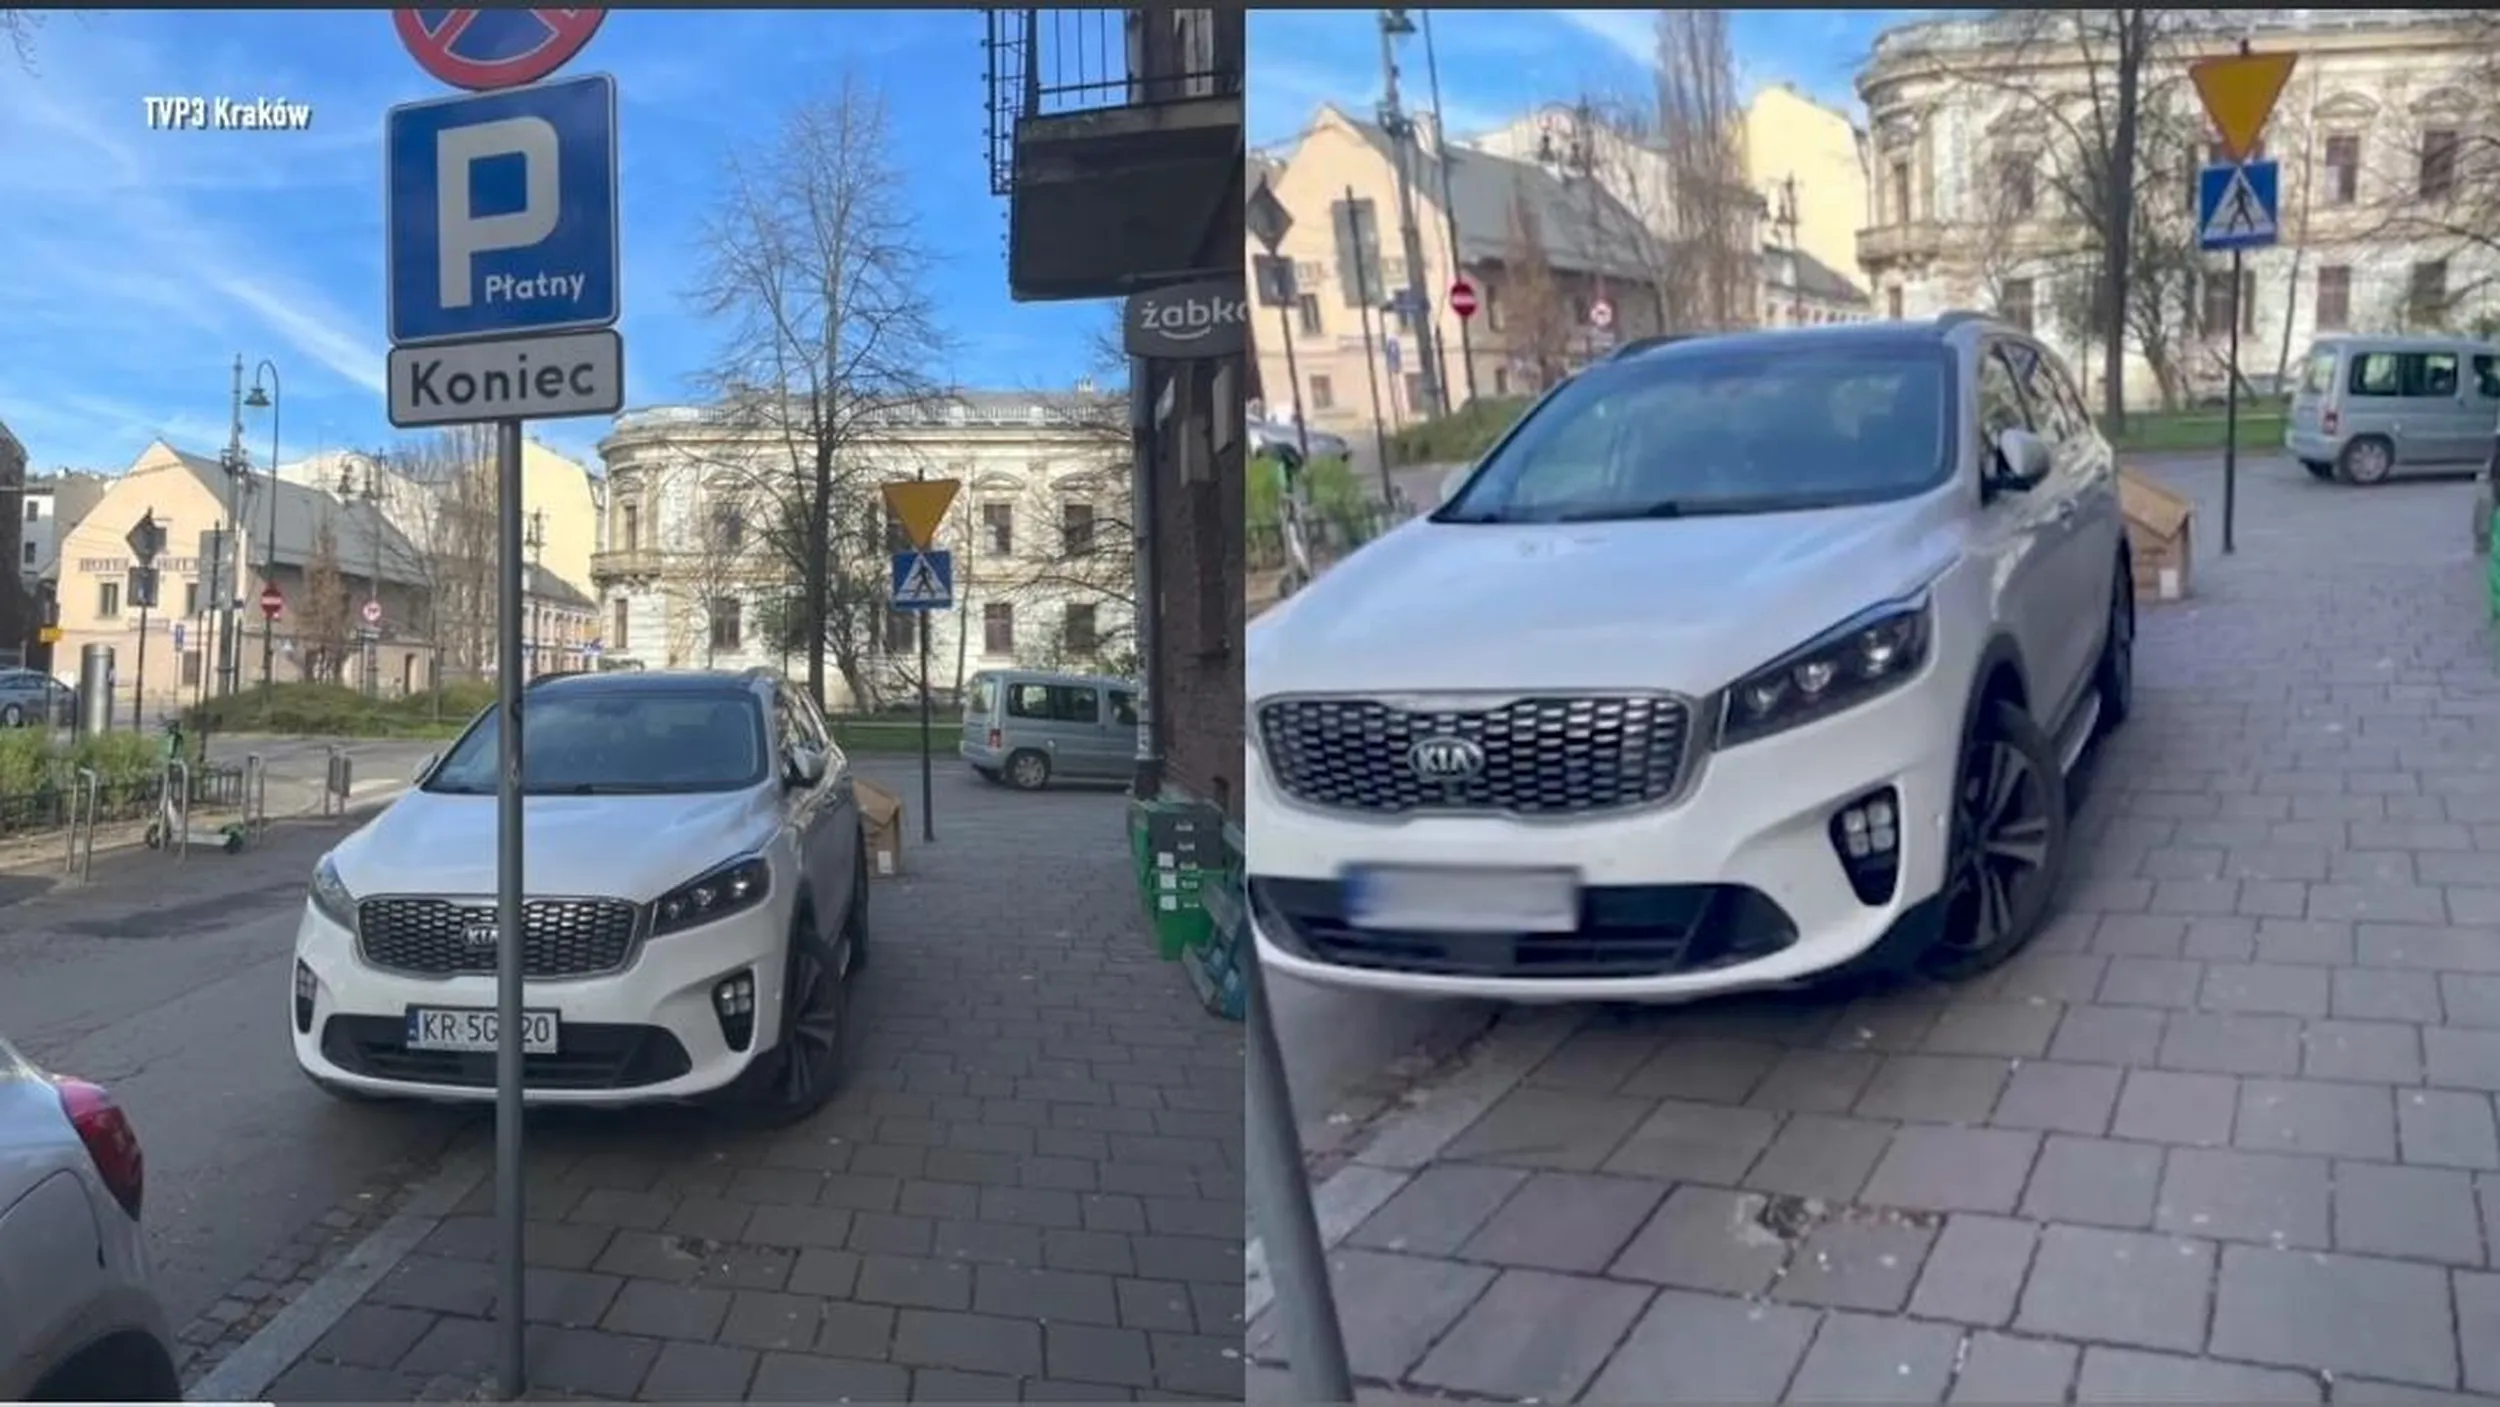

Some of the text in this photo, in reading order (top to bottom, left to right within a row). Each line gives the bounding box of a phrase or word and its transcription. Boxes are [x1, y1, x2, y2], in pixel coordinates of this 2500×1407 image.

[437, 116, 560, 309] P
[485, 271, 585, 304] Płatny
[411, 353, 595, 408] Koniec
[1418, 746, 1471, 772] KIA
[423, 1012, 457, 1042] KR
[467, 1014, 550, 1043] 5G20
